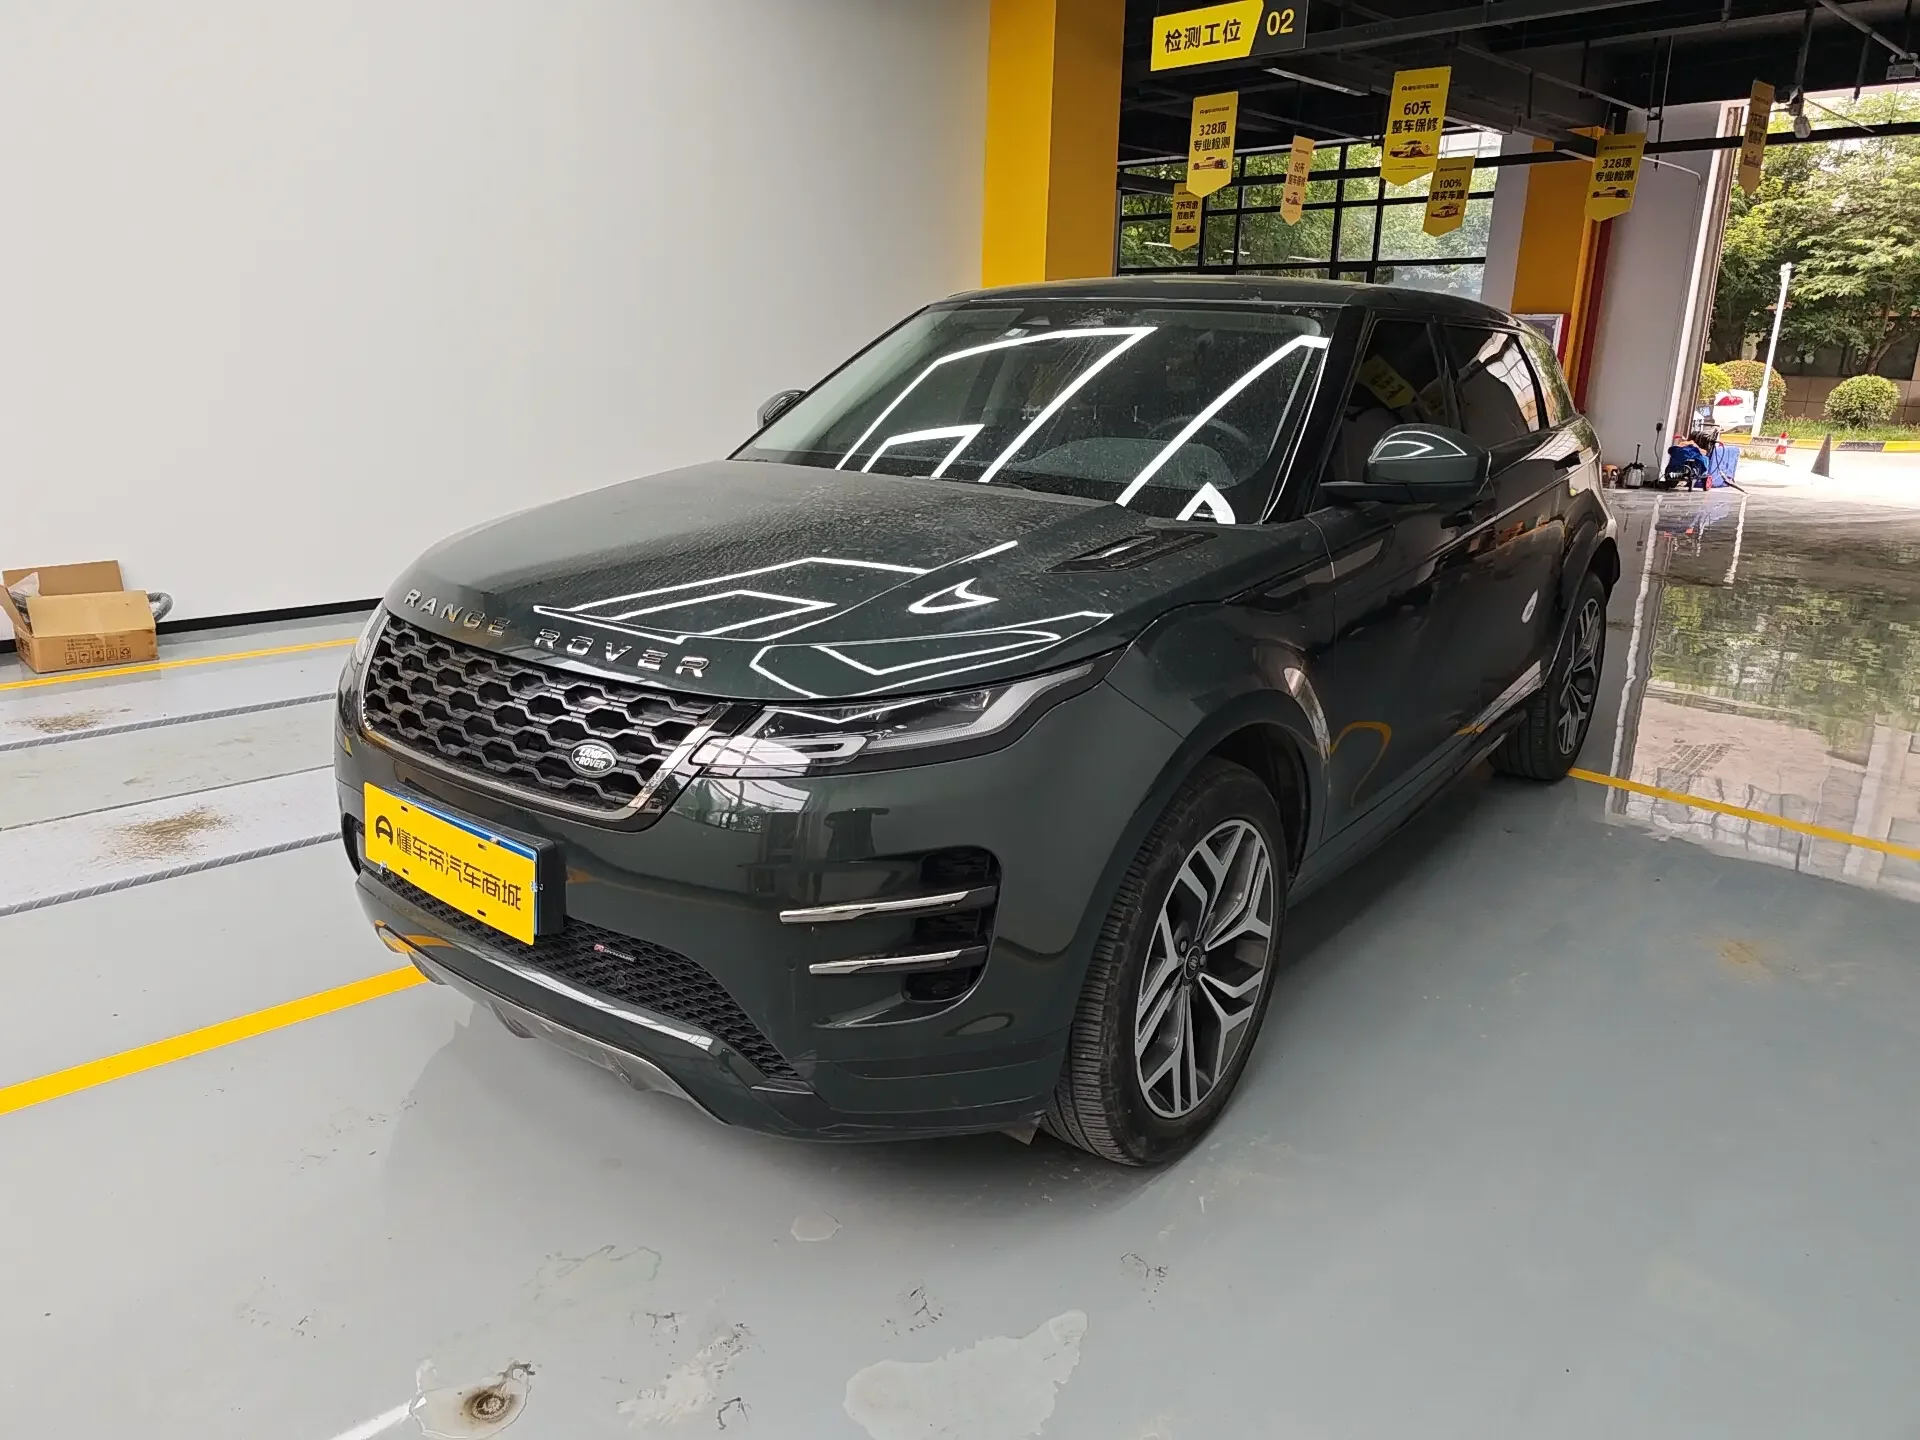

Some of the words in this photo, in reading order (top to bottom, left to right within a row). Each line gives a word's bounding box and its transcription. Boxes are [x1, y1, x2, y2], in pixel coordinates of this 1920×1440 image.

[1164, 18, 1242, 53] 检测工位
[1266, 8, 1295, 36] 02
[1403, 100, 1432, 116] 60天
[1199, 121, 1228, 137] 328项
[1391, 117, 1439, 134] 整车保修
[1193, 136, 1231, 152] 专业检测
[1602, 157, 1632, 169] 328项
[1440, 178, 1462, 189] 100%
[404, 588, 511, 637] RANGE
[534, 628, 710, 678] ROVER
[578, 747, 602, 759] LAND
[578, 757, 607, 769] ROVER
[396, 826, 522, 912] 懂车帝汽车商城
